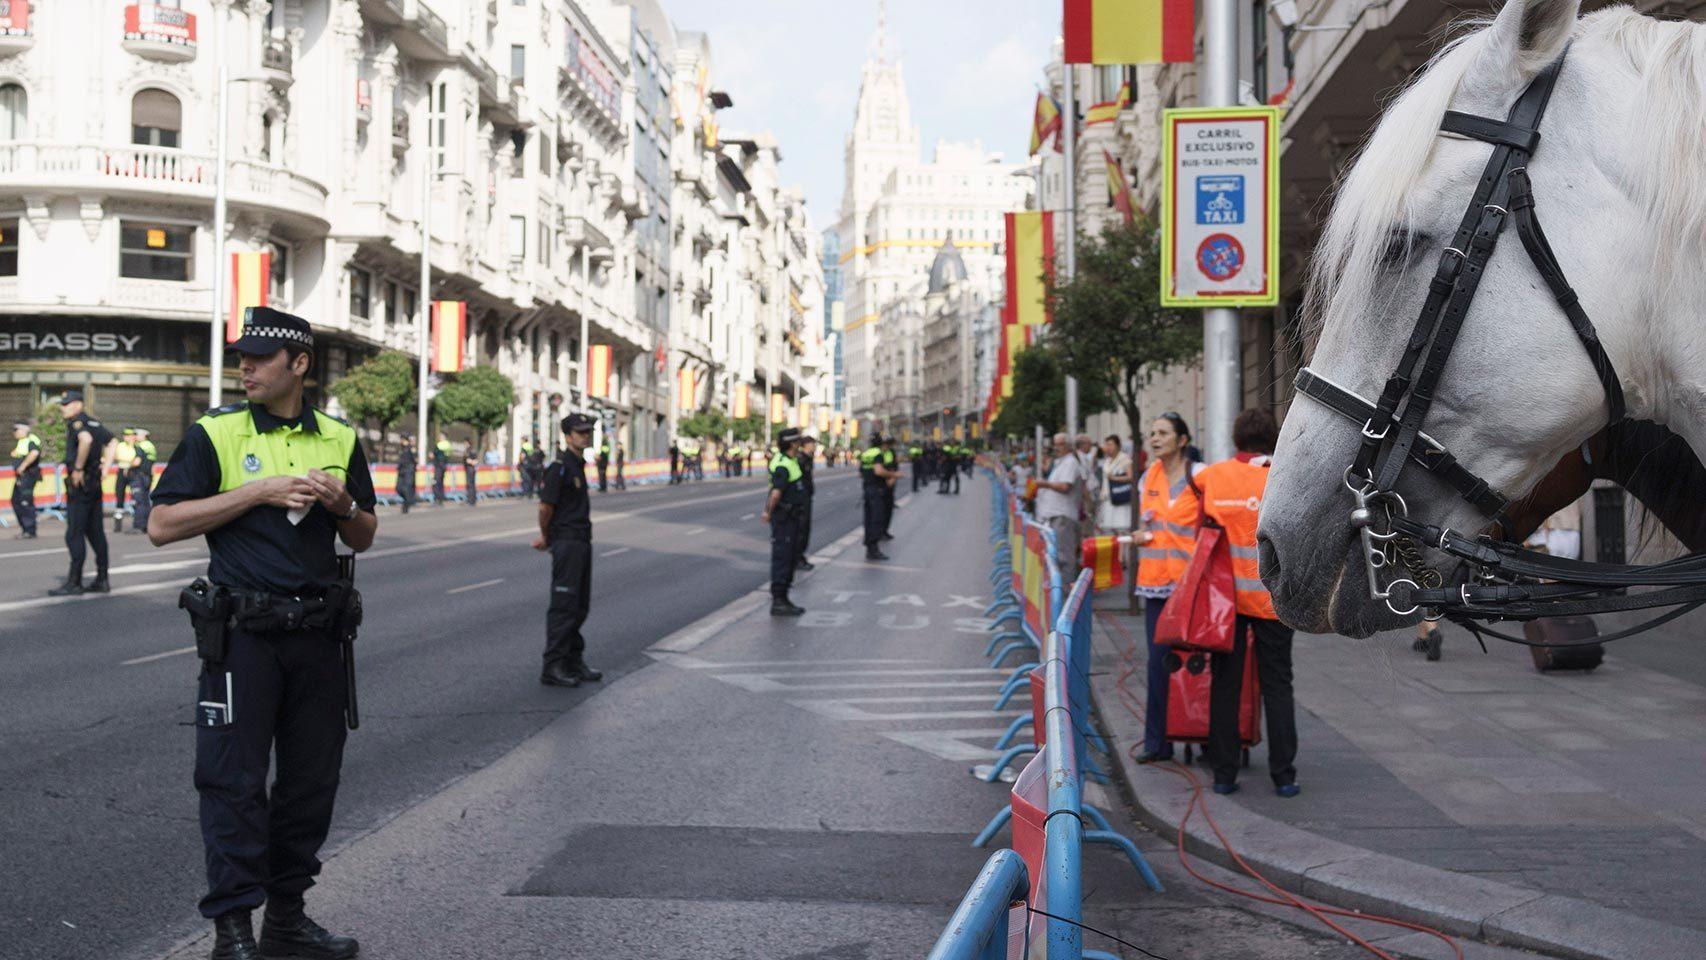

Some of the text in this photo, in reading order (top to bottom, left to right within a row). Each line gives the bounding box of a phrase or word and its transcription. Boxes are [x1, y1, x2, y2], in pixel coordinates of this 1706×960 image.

[1197, 129, 1242, 139] CARRIL
[1185, 141, 1255, 152] EXCLUSIVO
[1203, 210, 1238, 223] TAXI
[796, 610, 1006, 634] BUS
